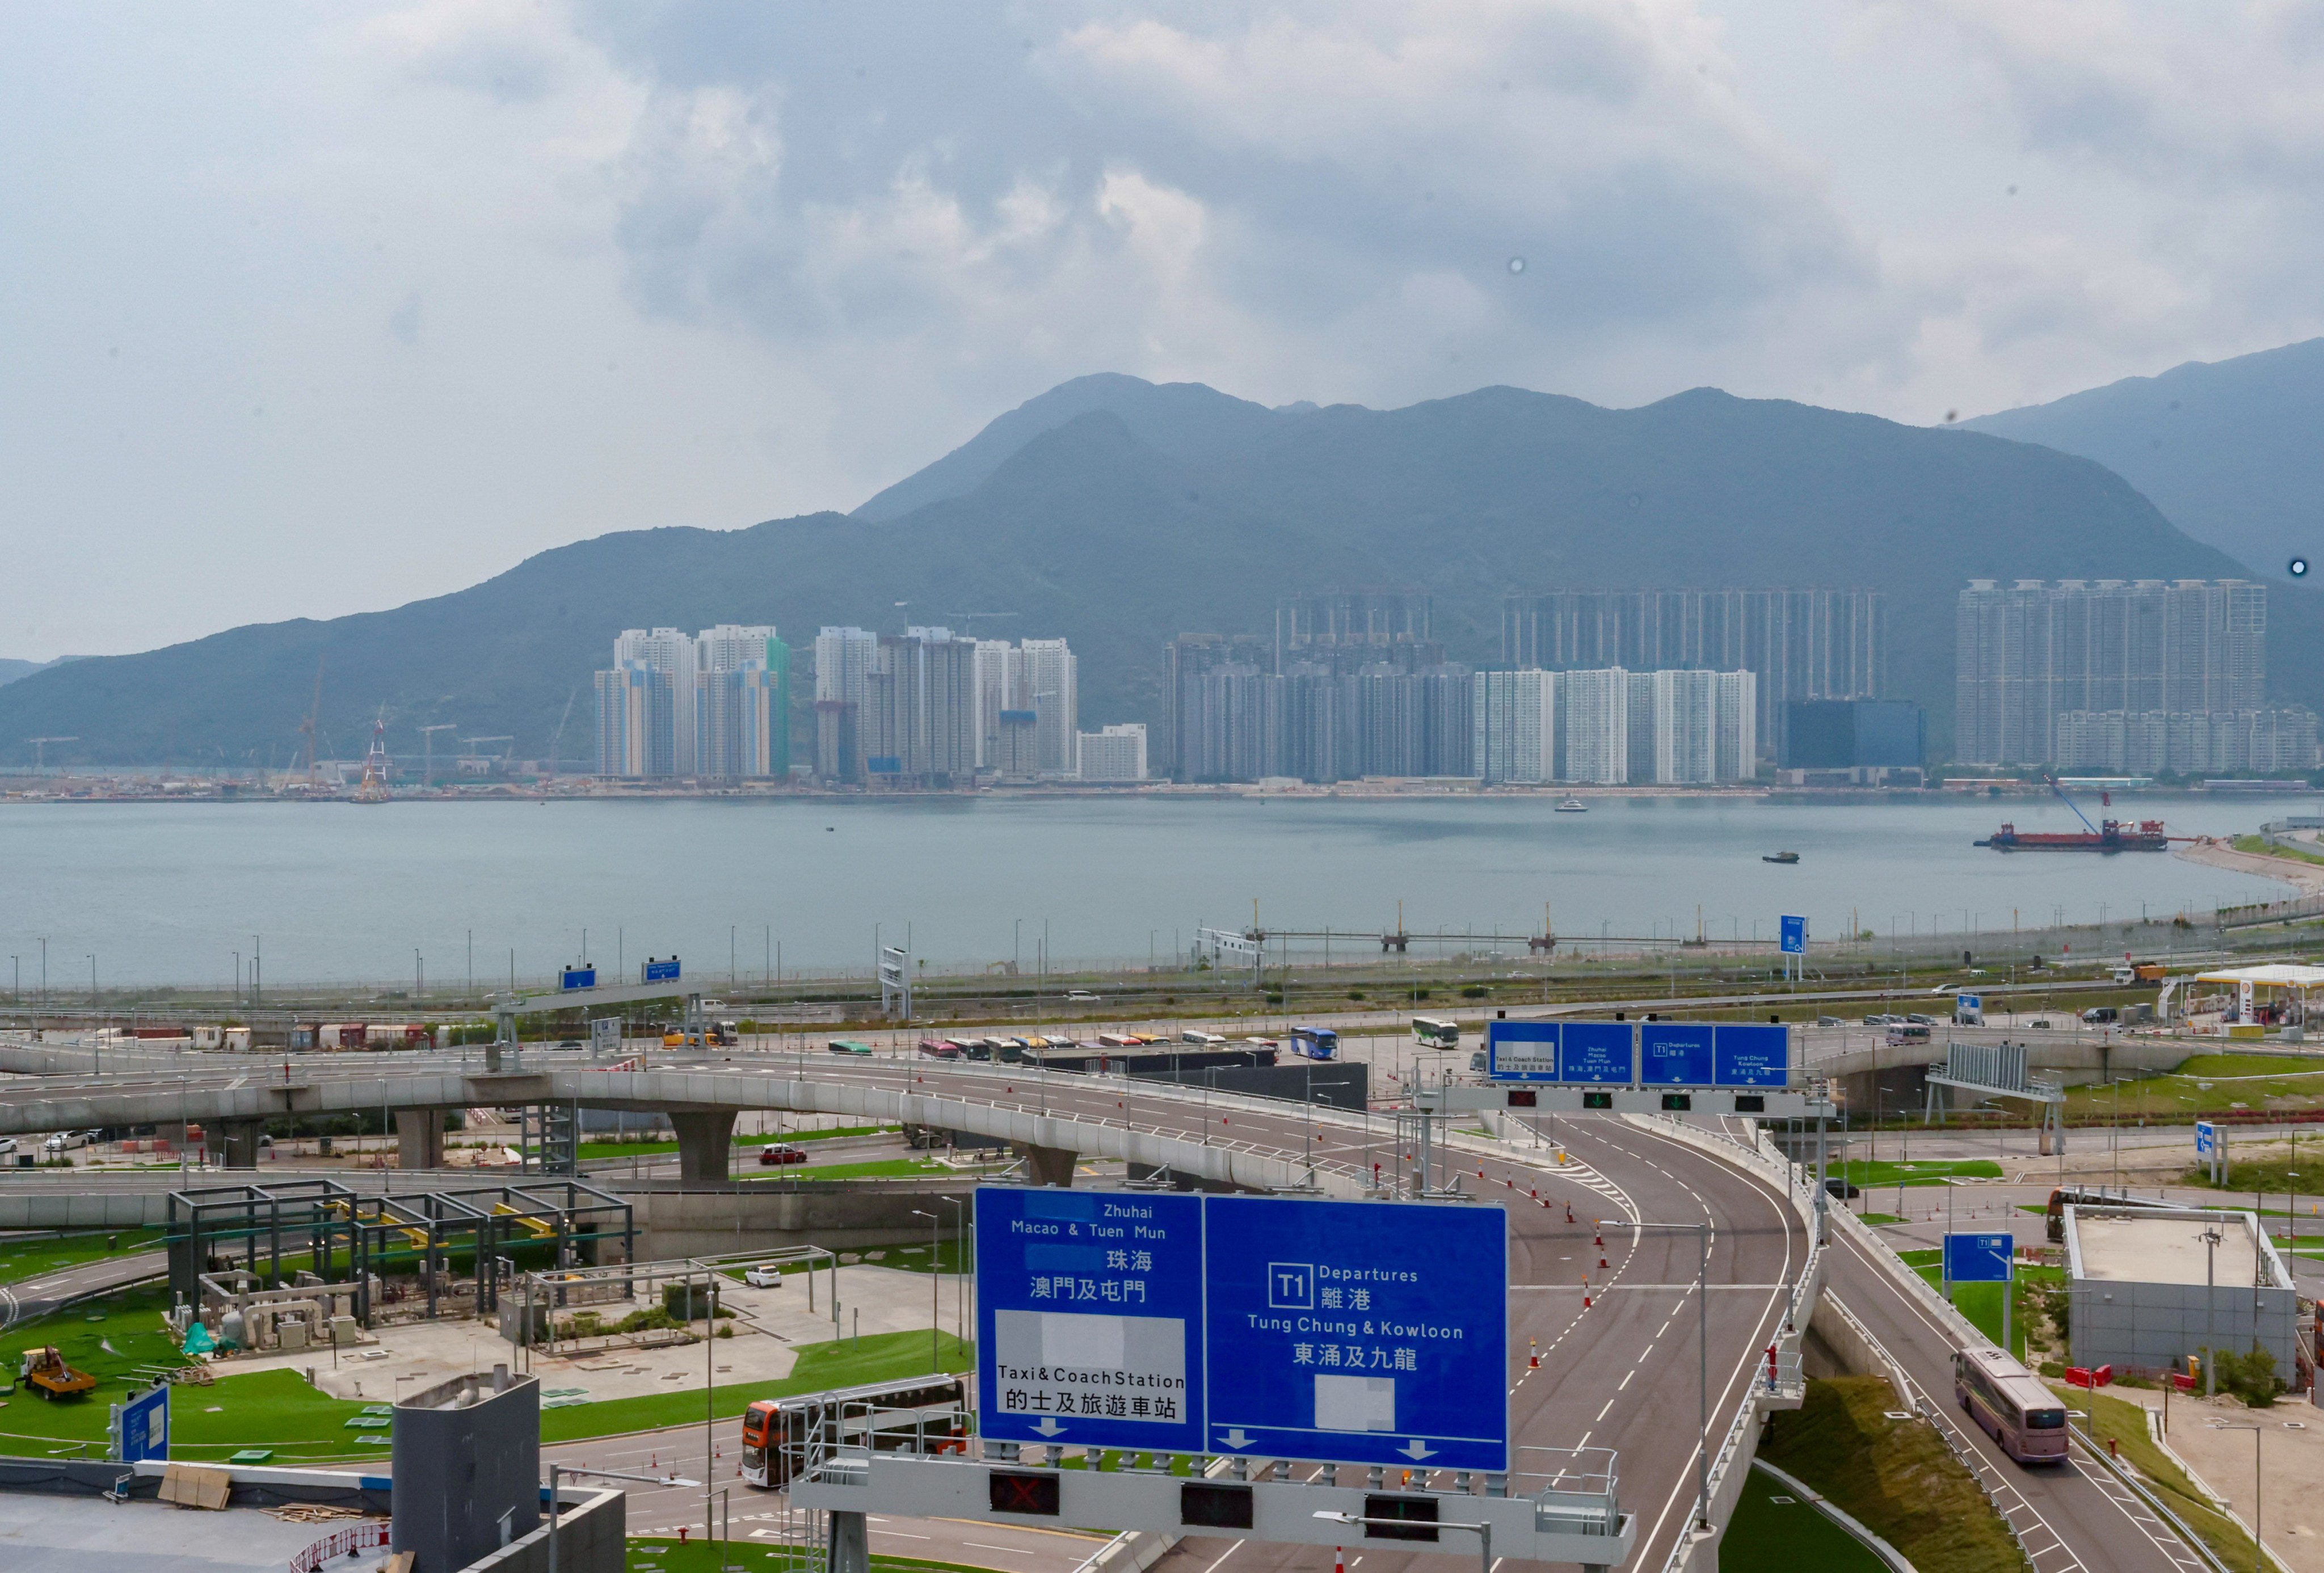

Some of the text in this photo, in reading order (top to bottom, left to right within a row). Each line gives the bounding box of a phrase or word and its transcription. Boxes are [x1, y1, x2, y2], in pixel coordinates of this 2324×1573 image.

[1104, 1204, 1152, 1218] Zhuhai
[1012, 1220, 1165, 1239] Macao & Tuen Mun
[1106, 1249, 1152, 1272] 珠海
[1278, 1274, 1303, 1297] T1
[1320, 1265, 1418, 1283] Departures
[1030, 1276, 1146, 1304] 澳門及屯門
[1321, 1287, 1371, 1311] 離港
[1248, 1314, 1463, 1339] Tung Chung & Kowloon
[1292, 1342, 1417, 1371] 東涌及九龍
[998, 1365, 1185, 1389] Taxi & Coach Station
[1006, 1388, 1176, 1419] 的士及旅遊車站
